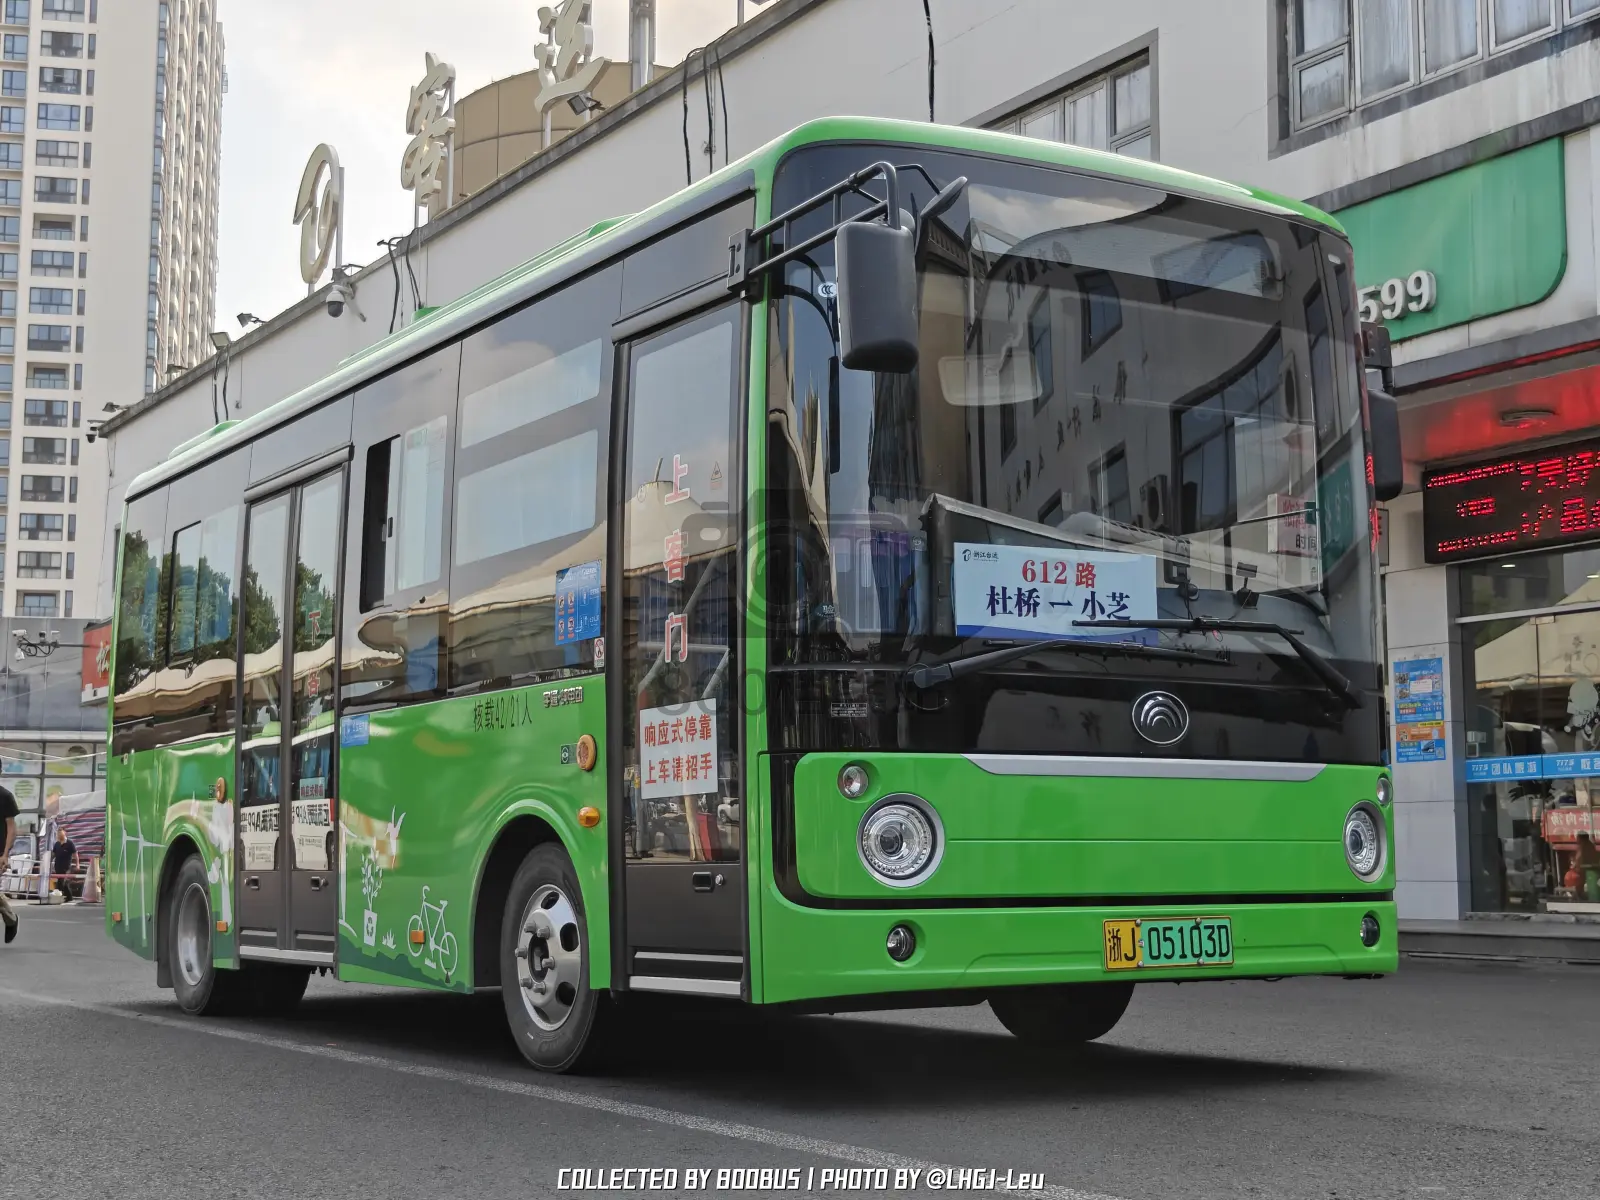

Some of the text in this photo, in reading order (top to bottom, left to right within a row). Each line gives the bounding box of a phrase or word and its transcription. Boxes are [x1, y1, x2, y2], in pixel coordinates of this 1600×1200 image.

[663, 453, 690, 663] 上客门
[1022, 559, 1096, 588] 612 路
[986, 585, 1131, 620] 杜桥 小芝
[644, 713, 712, 748] 响应式停靠
[644, 752, 713, 785] 上车请招手
